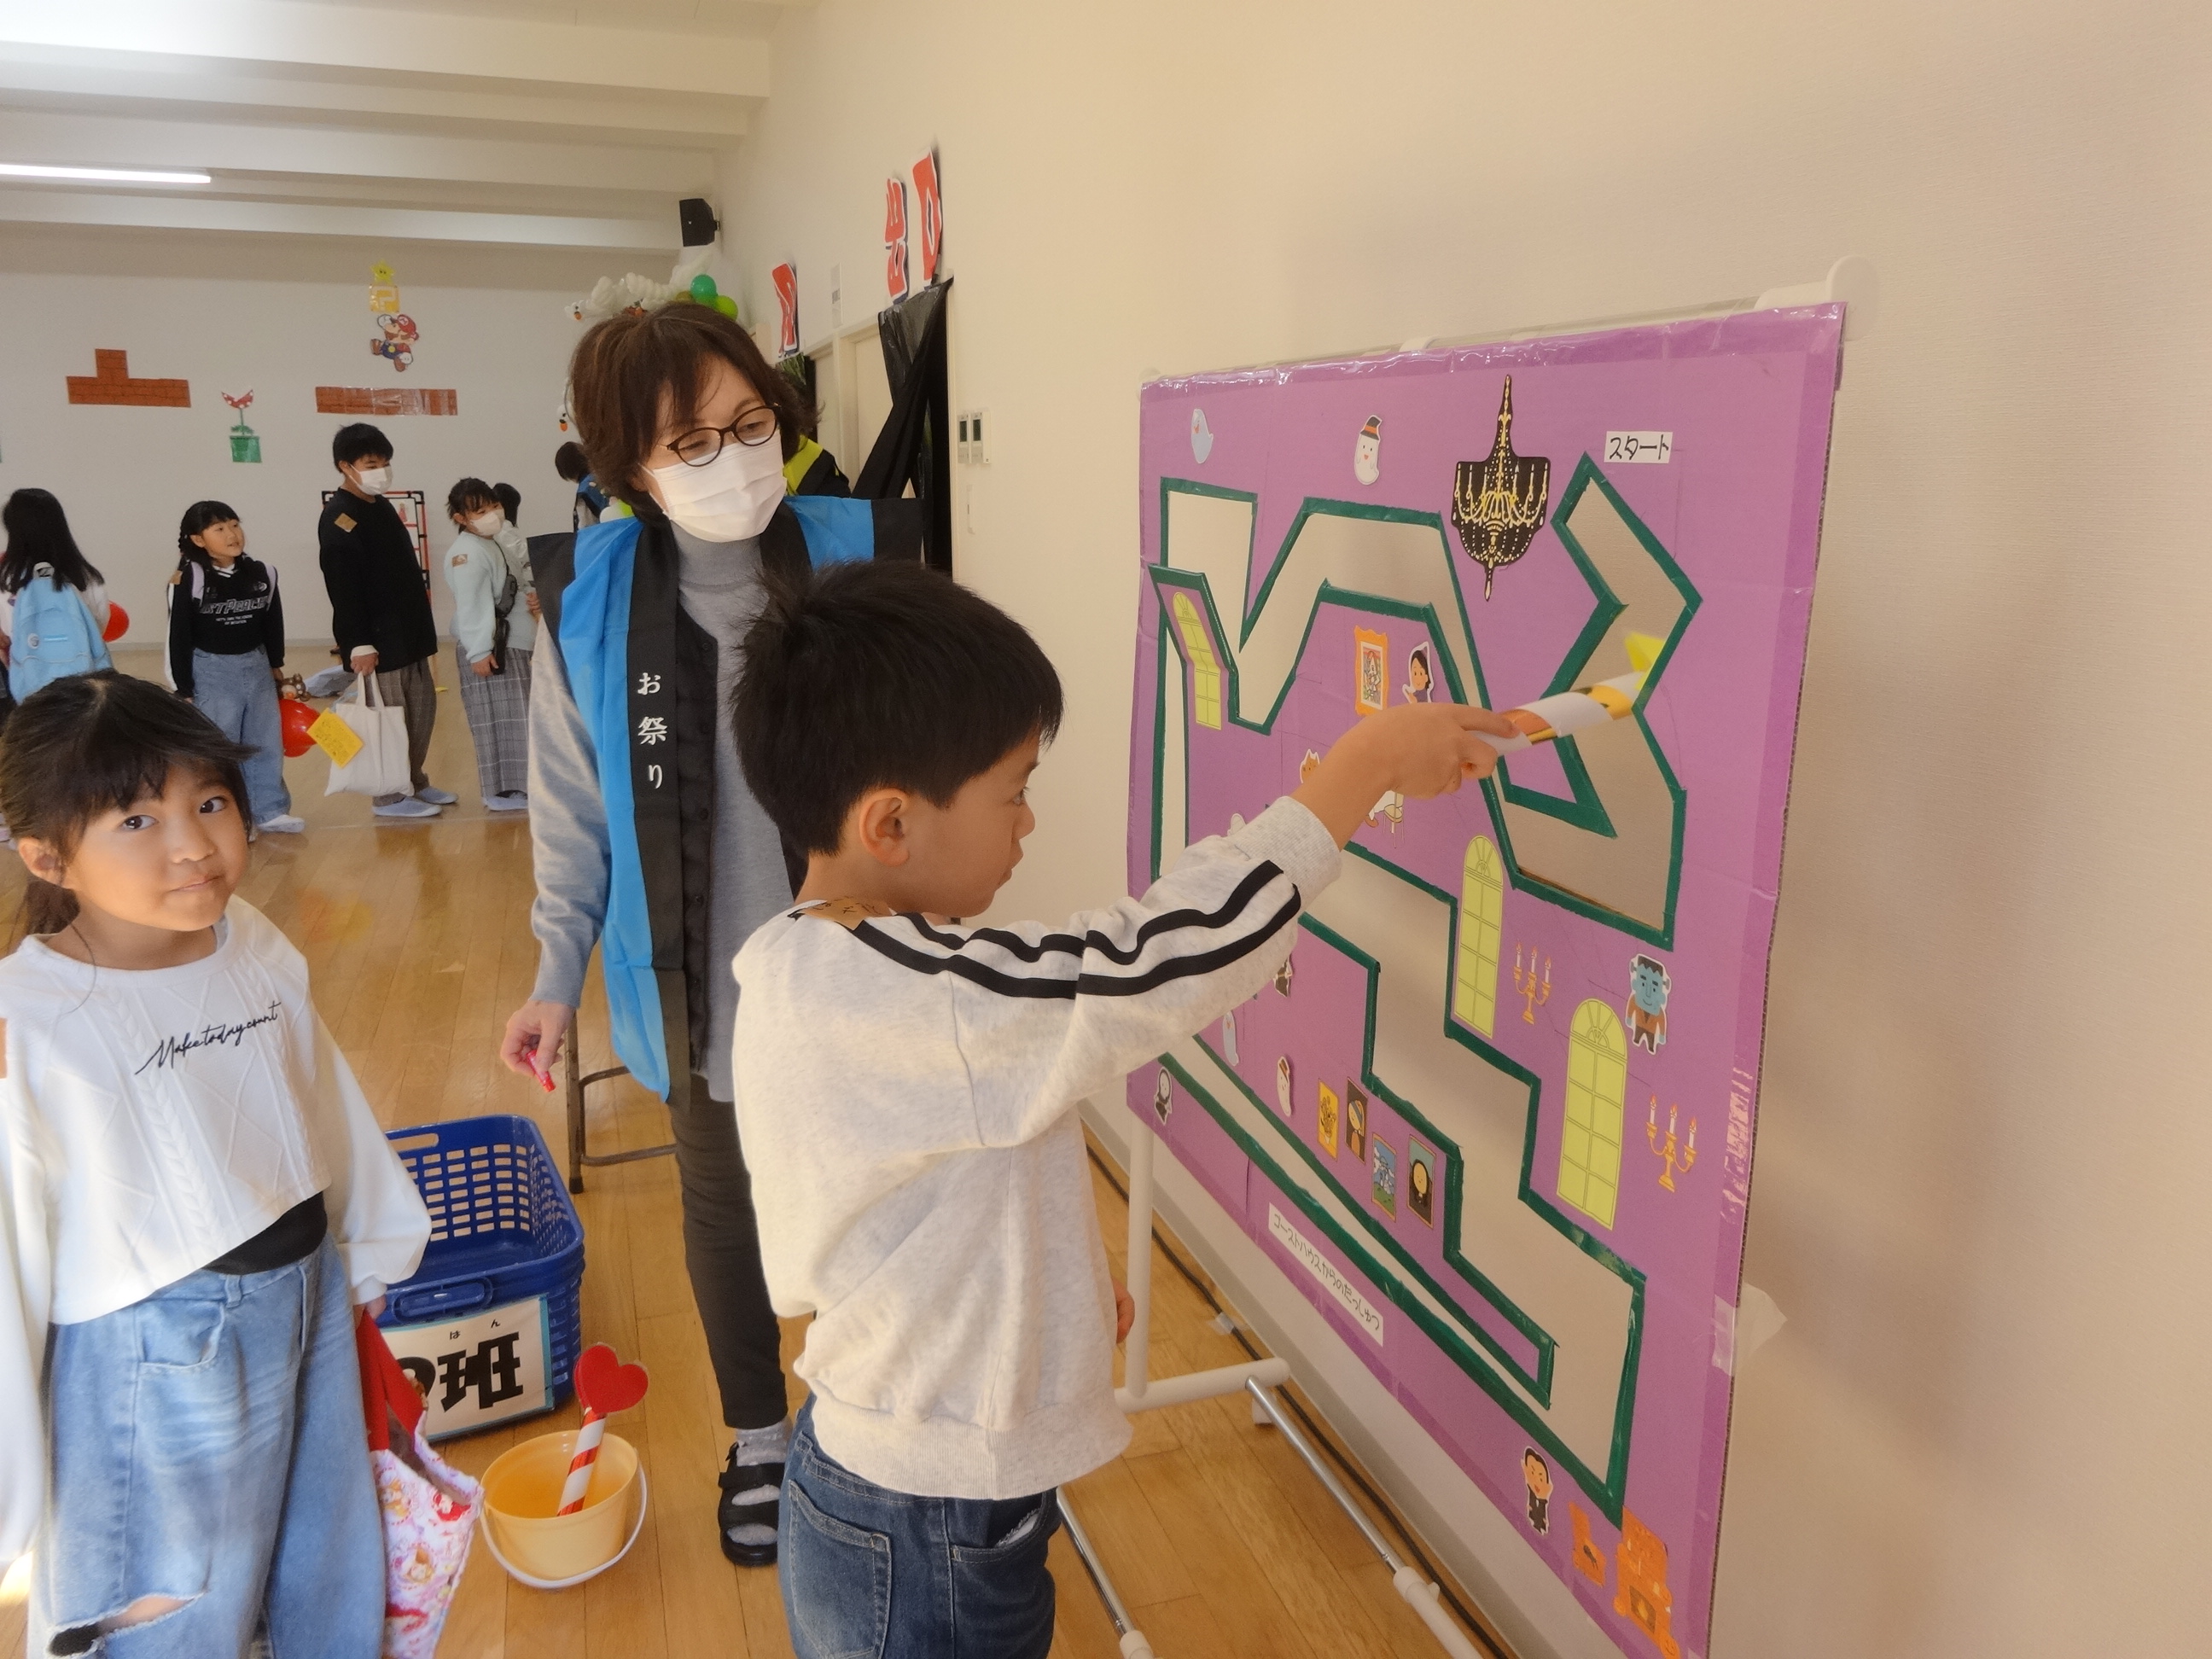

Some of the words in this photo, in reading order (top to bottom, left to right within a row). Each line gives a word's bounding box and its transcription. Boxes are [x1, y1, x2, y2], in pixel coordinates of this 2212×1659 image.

[1609, 434, 1670, 461] スタート
[637, 672, 668, 789] お祭り
[134, 1032, 204, 1075] Make
[201, 1024, 246, 1047] today
